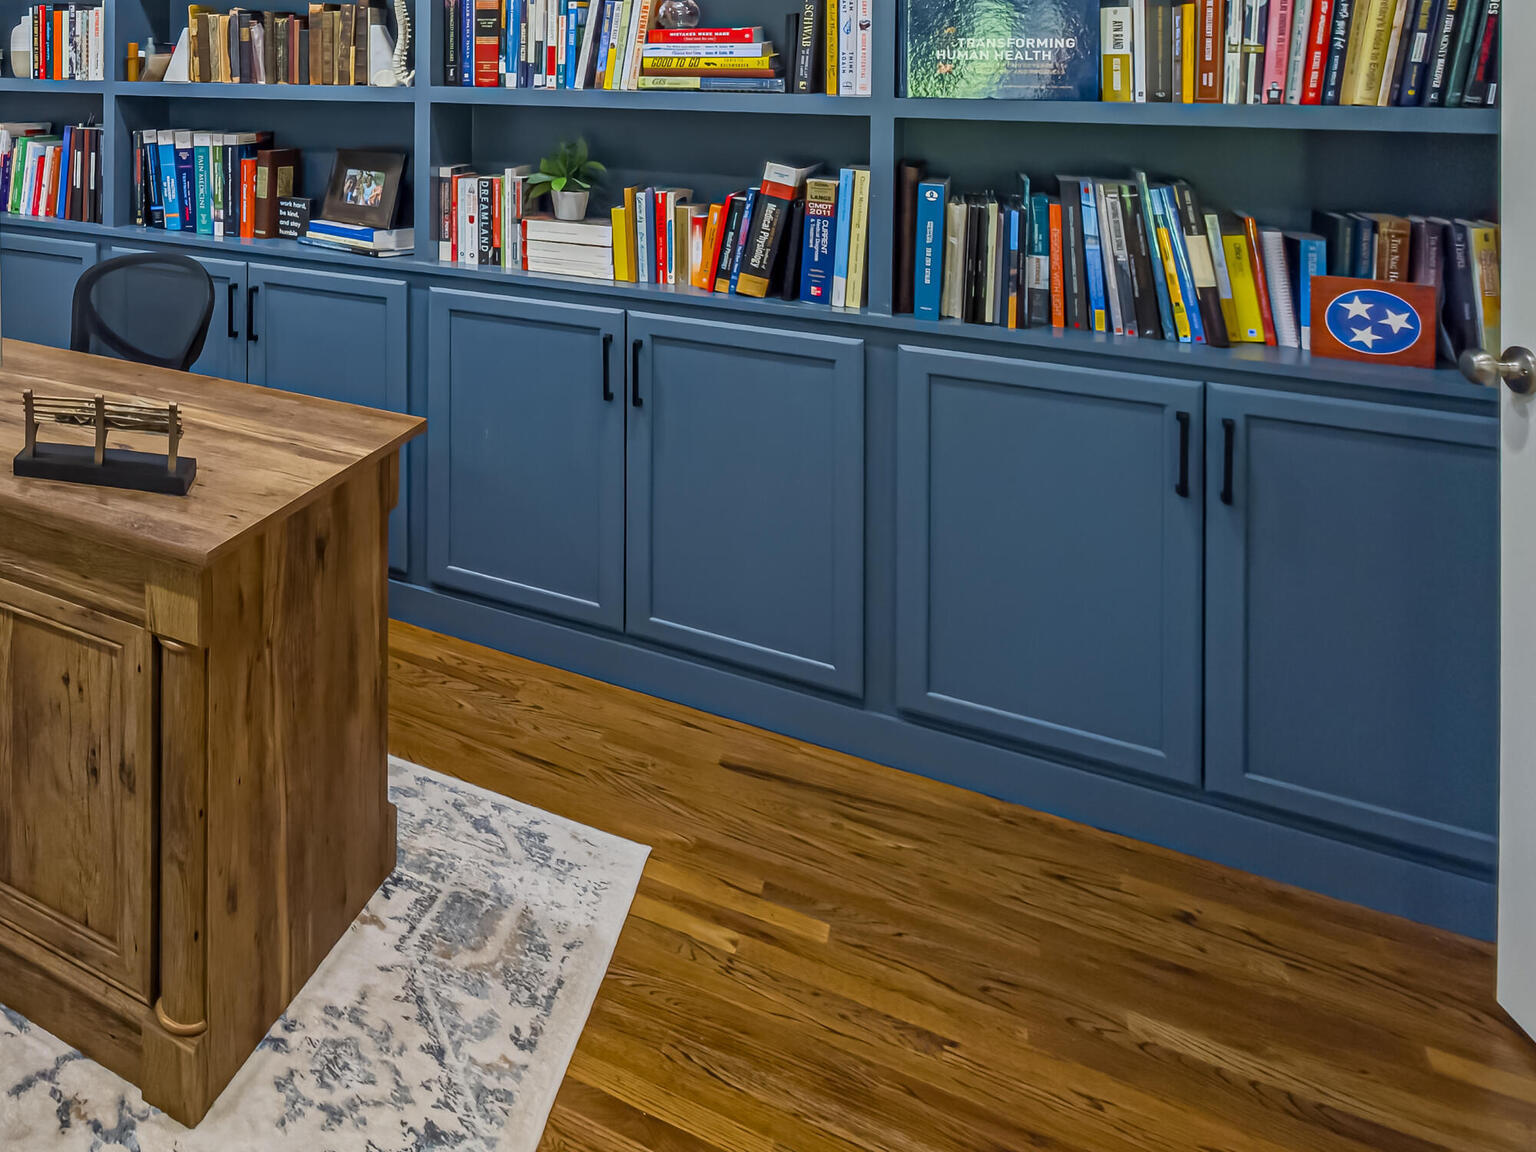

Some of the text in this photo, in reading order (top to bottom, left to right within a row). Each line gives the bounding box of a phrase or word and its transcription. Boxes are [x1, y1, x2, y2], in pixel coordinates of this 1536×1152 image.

[637, 5, 649, 44] REVENANT
[802, 4, 814, 47] SCHWAB
[956, 38, 1076, 48] TRANSFORMING
[1112, 20, 1123, 50] AYN RAND
[651, 57, 700, 67] GOOD TO GO
[937, 50, 1052, 61] HUMAN HEALTH
[287, 210, 299, 218] kind,
[293, 202, 306, 210] hard,
[481, 181, 489, 252] DREAMLAND
[761, 203, 776, 230] Medical
[279, 228, 298, 236] humble
[750, 231, 769, 268] Physiology
